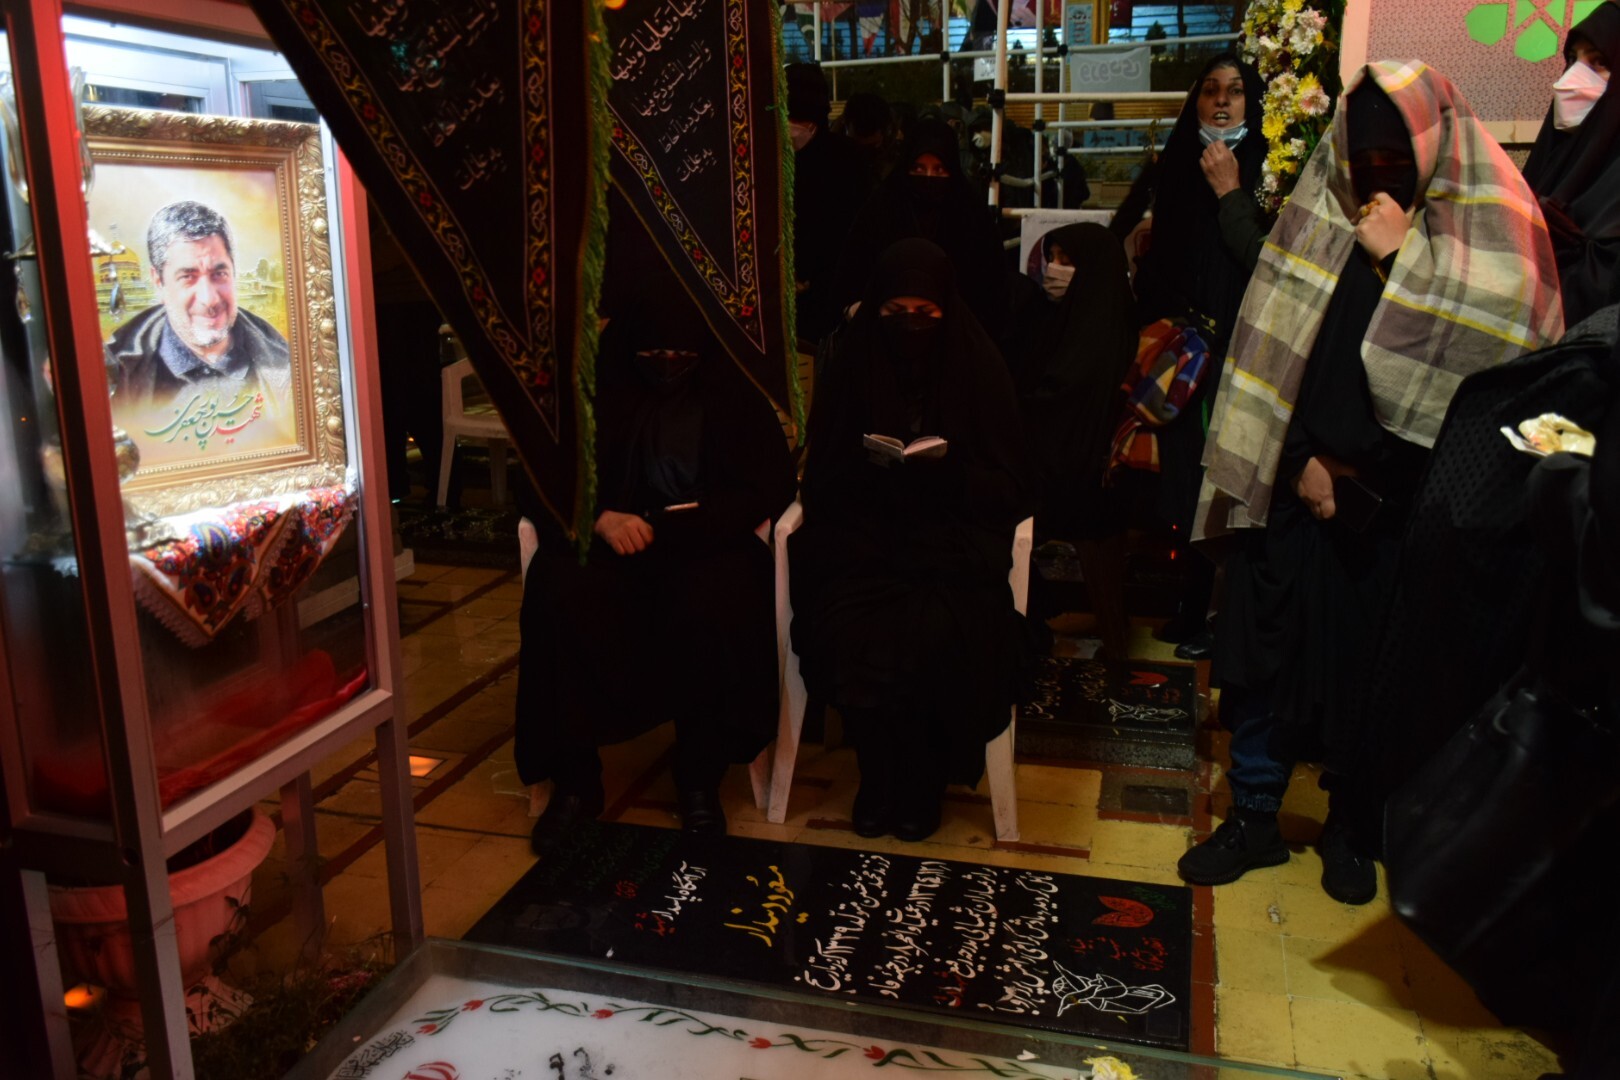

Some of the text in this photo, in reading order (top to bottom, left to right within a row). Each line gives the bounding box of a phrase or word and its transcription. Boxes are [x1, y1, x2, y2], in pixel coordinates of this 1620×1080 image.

[196, 394, 254, 439] حسین
[209, 392, 263, 444] شهید
[672, 860, 708, 896] آرامگاه
[859, 854, 890, 876] فرزند
[651, 895, 703, 921] پاسدار
[723, 902, 809, 947] دیندار
